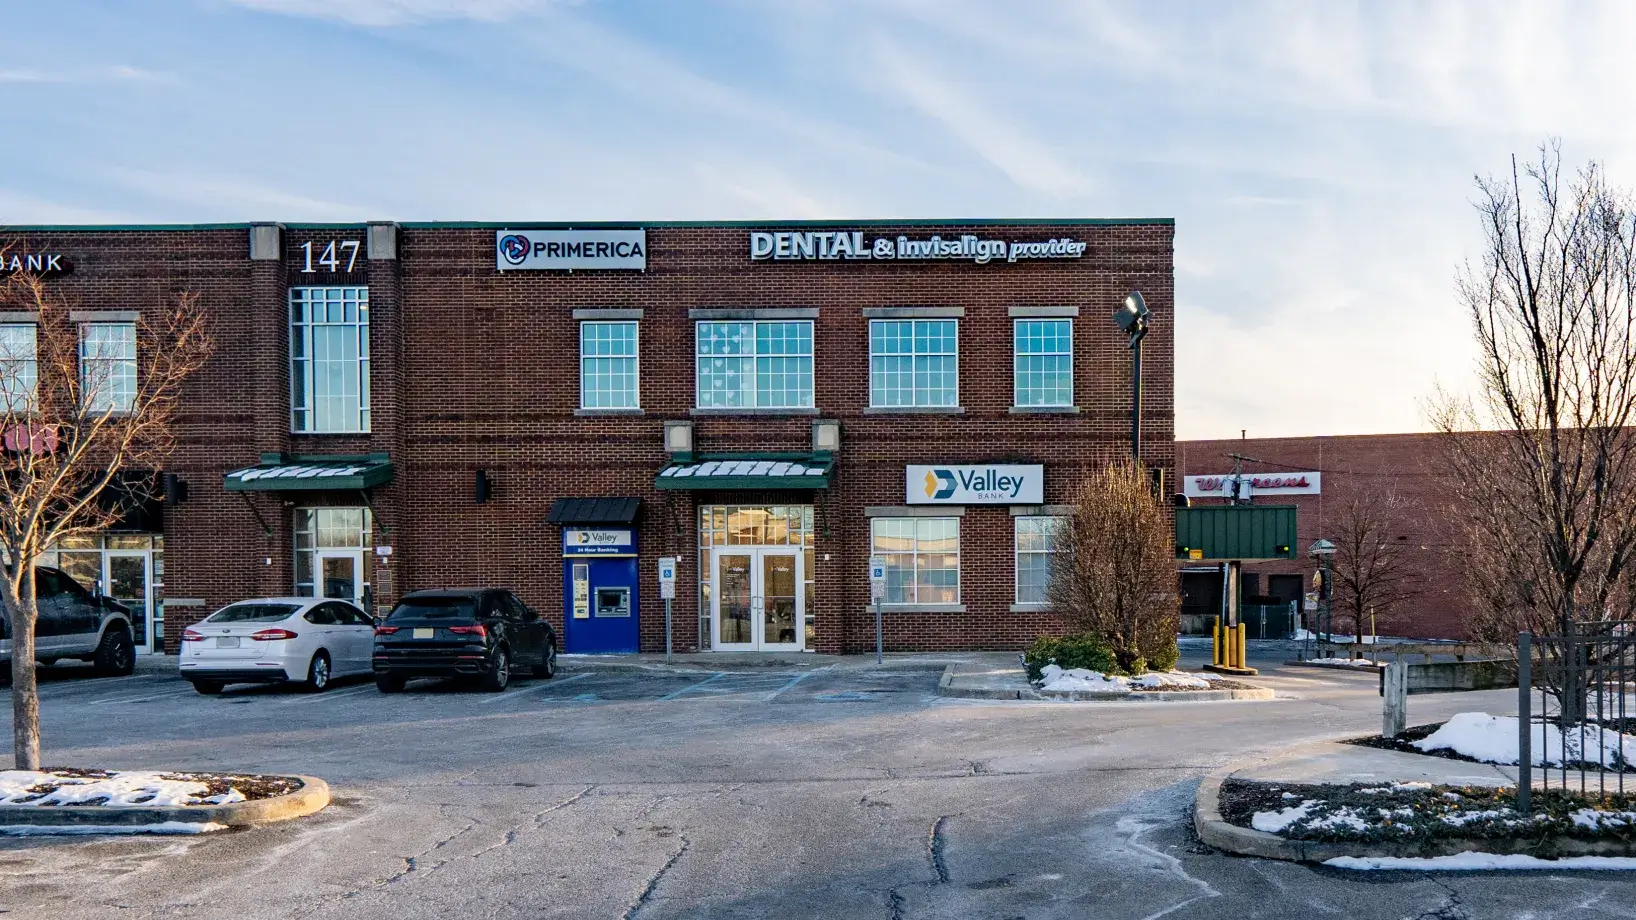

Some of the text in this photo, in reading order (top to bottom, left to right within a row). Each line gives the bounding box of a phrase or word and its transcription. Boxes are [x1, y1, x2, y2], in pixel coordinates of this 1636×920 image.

[300, 240, 360, 273] 147
[533, 241, 644, 258] PRIMERICA
[751, 231, 1087, 264] DENTAL & invisalign provider
[958, 469, 1024, 498] Valley
[978, 492, 1004, 500] BANK
[592, 532, 618, 544] Valley
